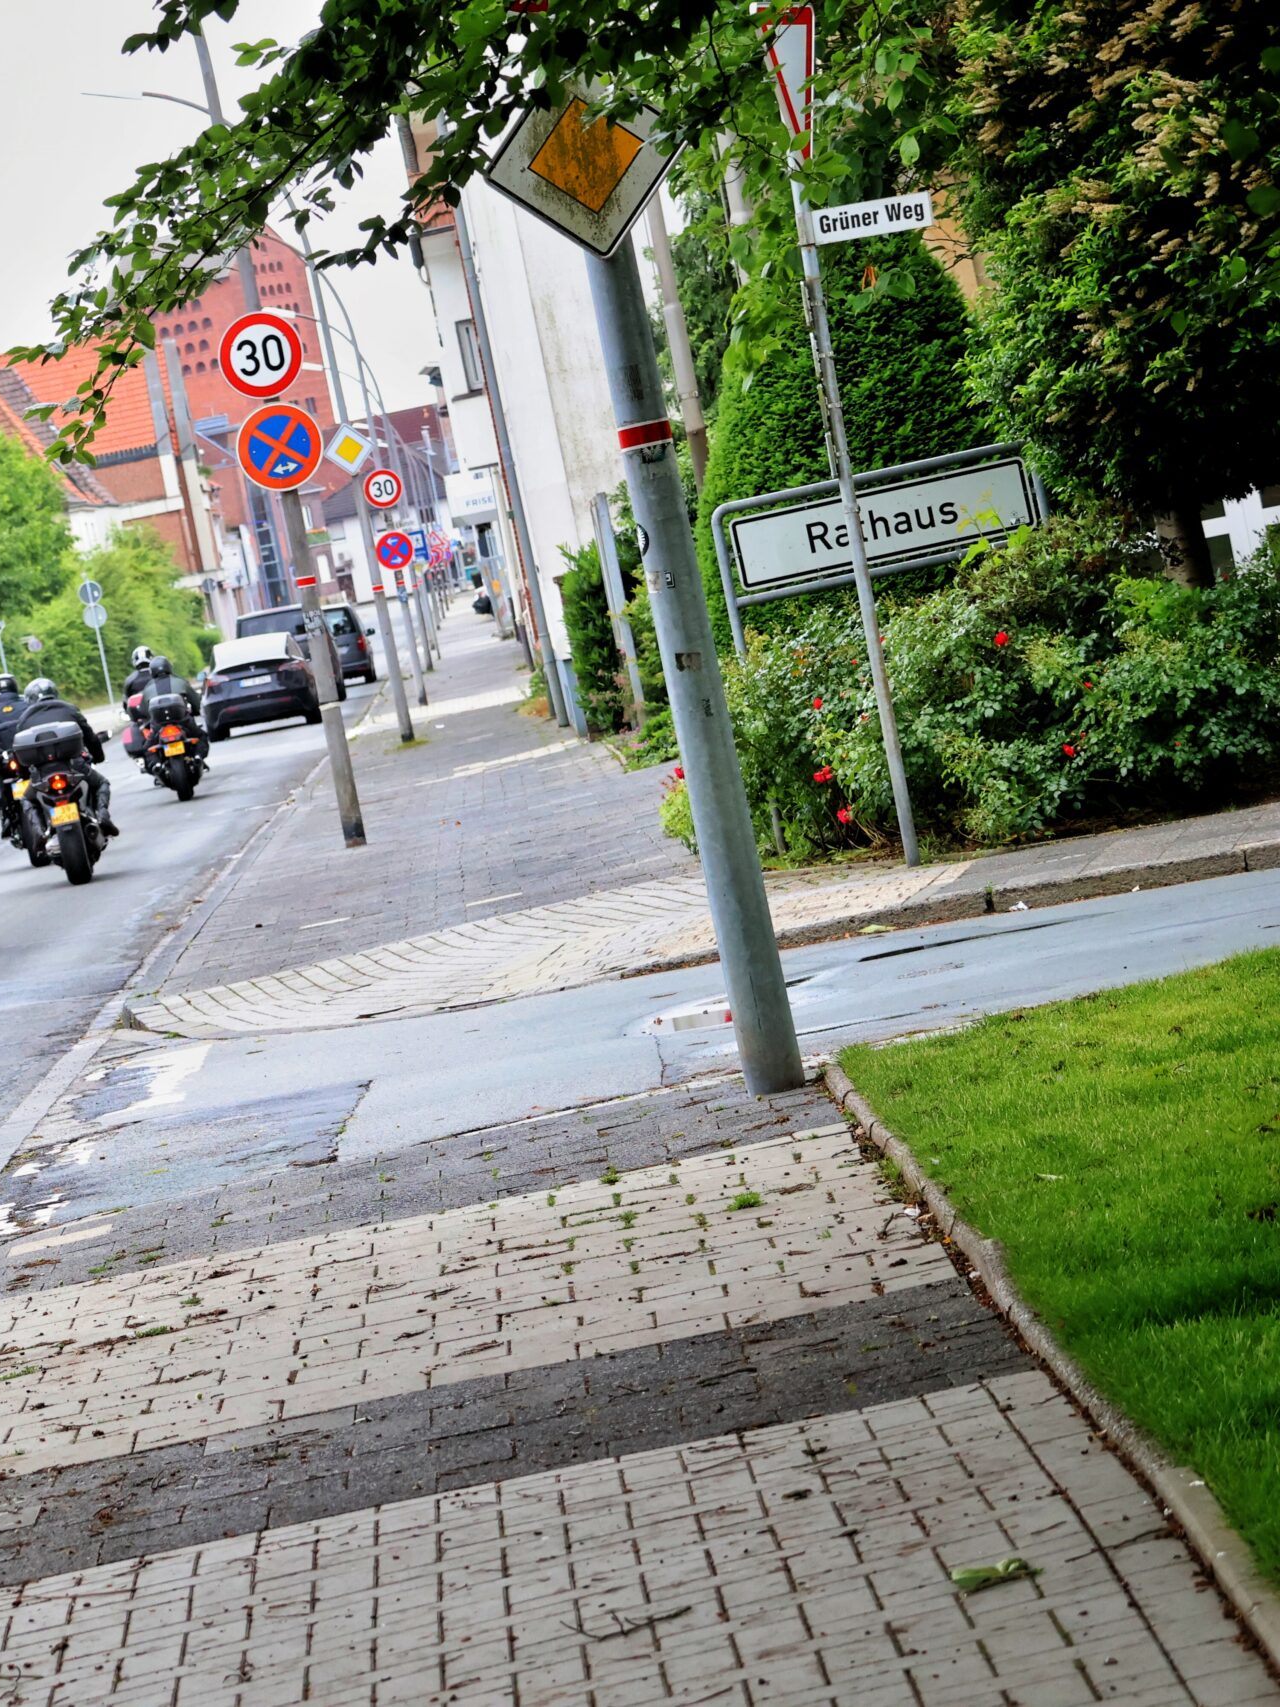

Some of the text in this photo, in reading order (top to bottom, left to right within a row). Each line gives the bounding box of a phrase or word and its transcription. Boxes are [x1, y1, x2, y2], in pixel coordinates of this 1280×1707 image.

[819, 202, 925, 234] Grüner Weg
[237, 334, 285, 377] 30
[372, 479, 394, 498] 30
